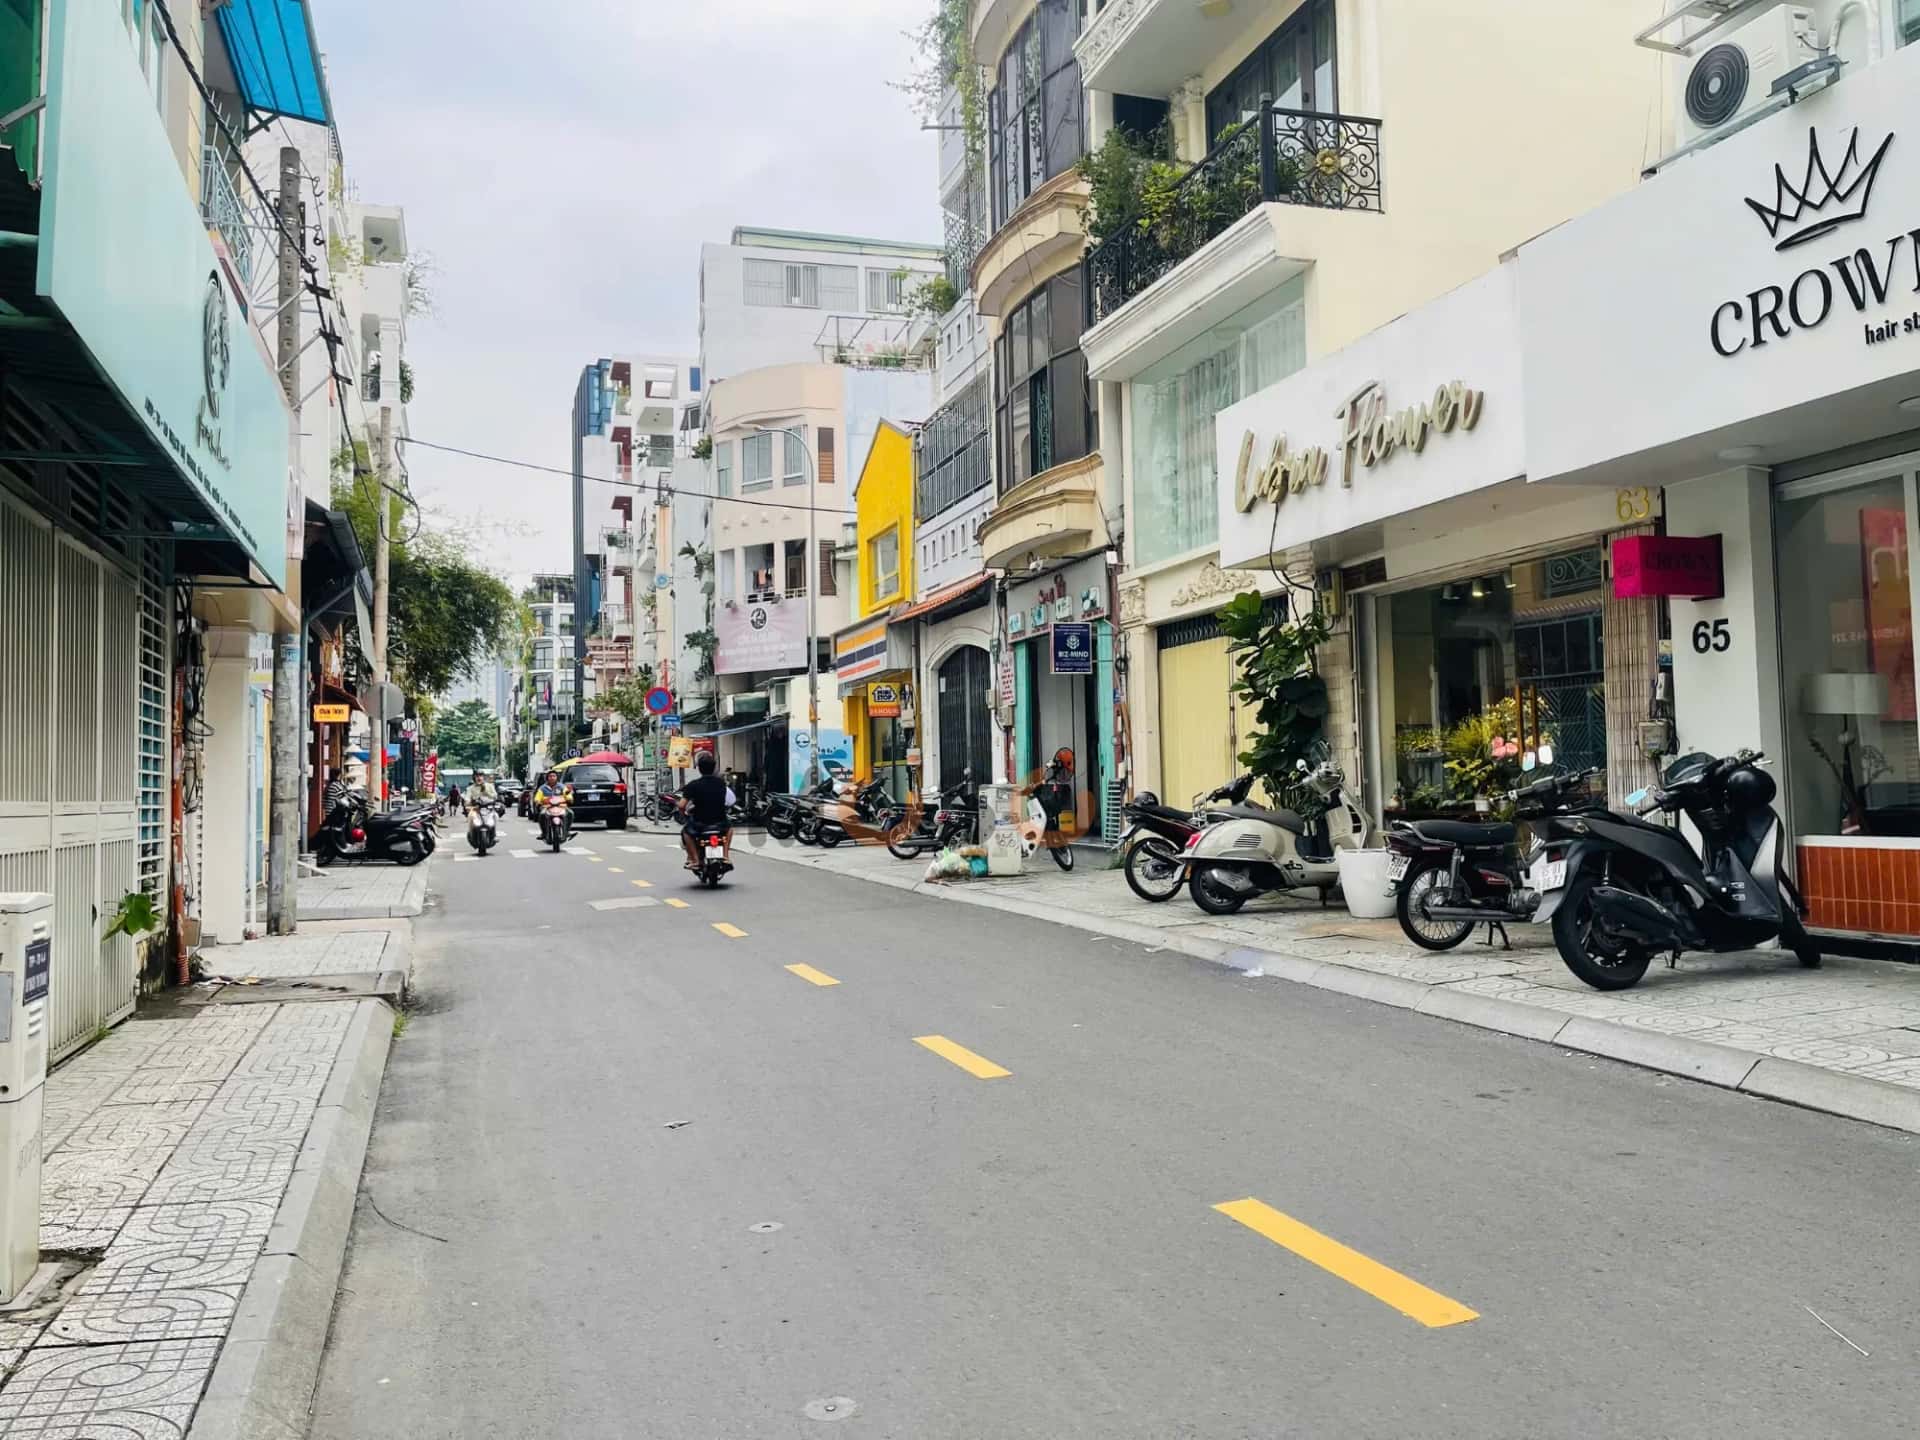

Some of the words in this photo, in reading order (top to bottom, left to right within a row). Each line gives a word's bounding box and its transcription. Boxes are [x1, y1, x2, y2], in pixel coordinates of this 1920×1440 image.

[1864, 319, 1899, 346] hair
[1903, 311, 1920, 333] st
[1335, 380, 1484, 489] Flower
[1616, 486, 1649, 523] 63
[1692, 618, 1731, 654] 65
